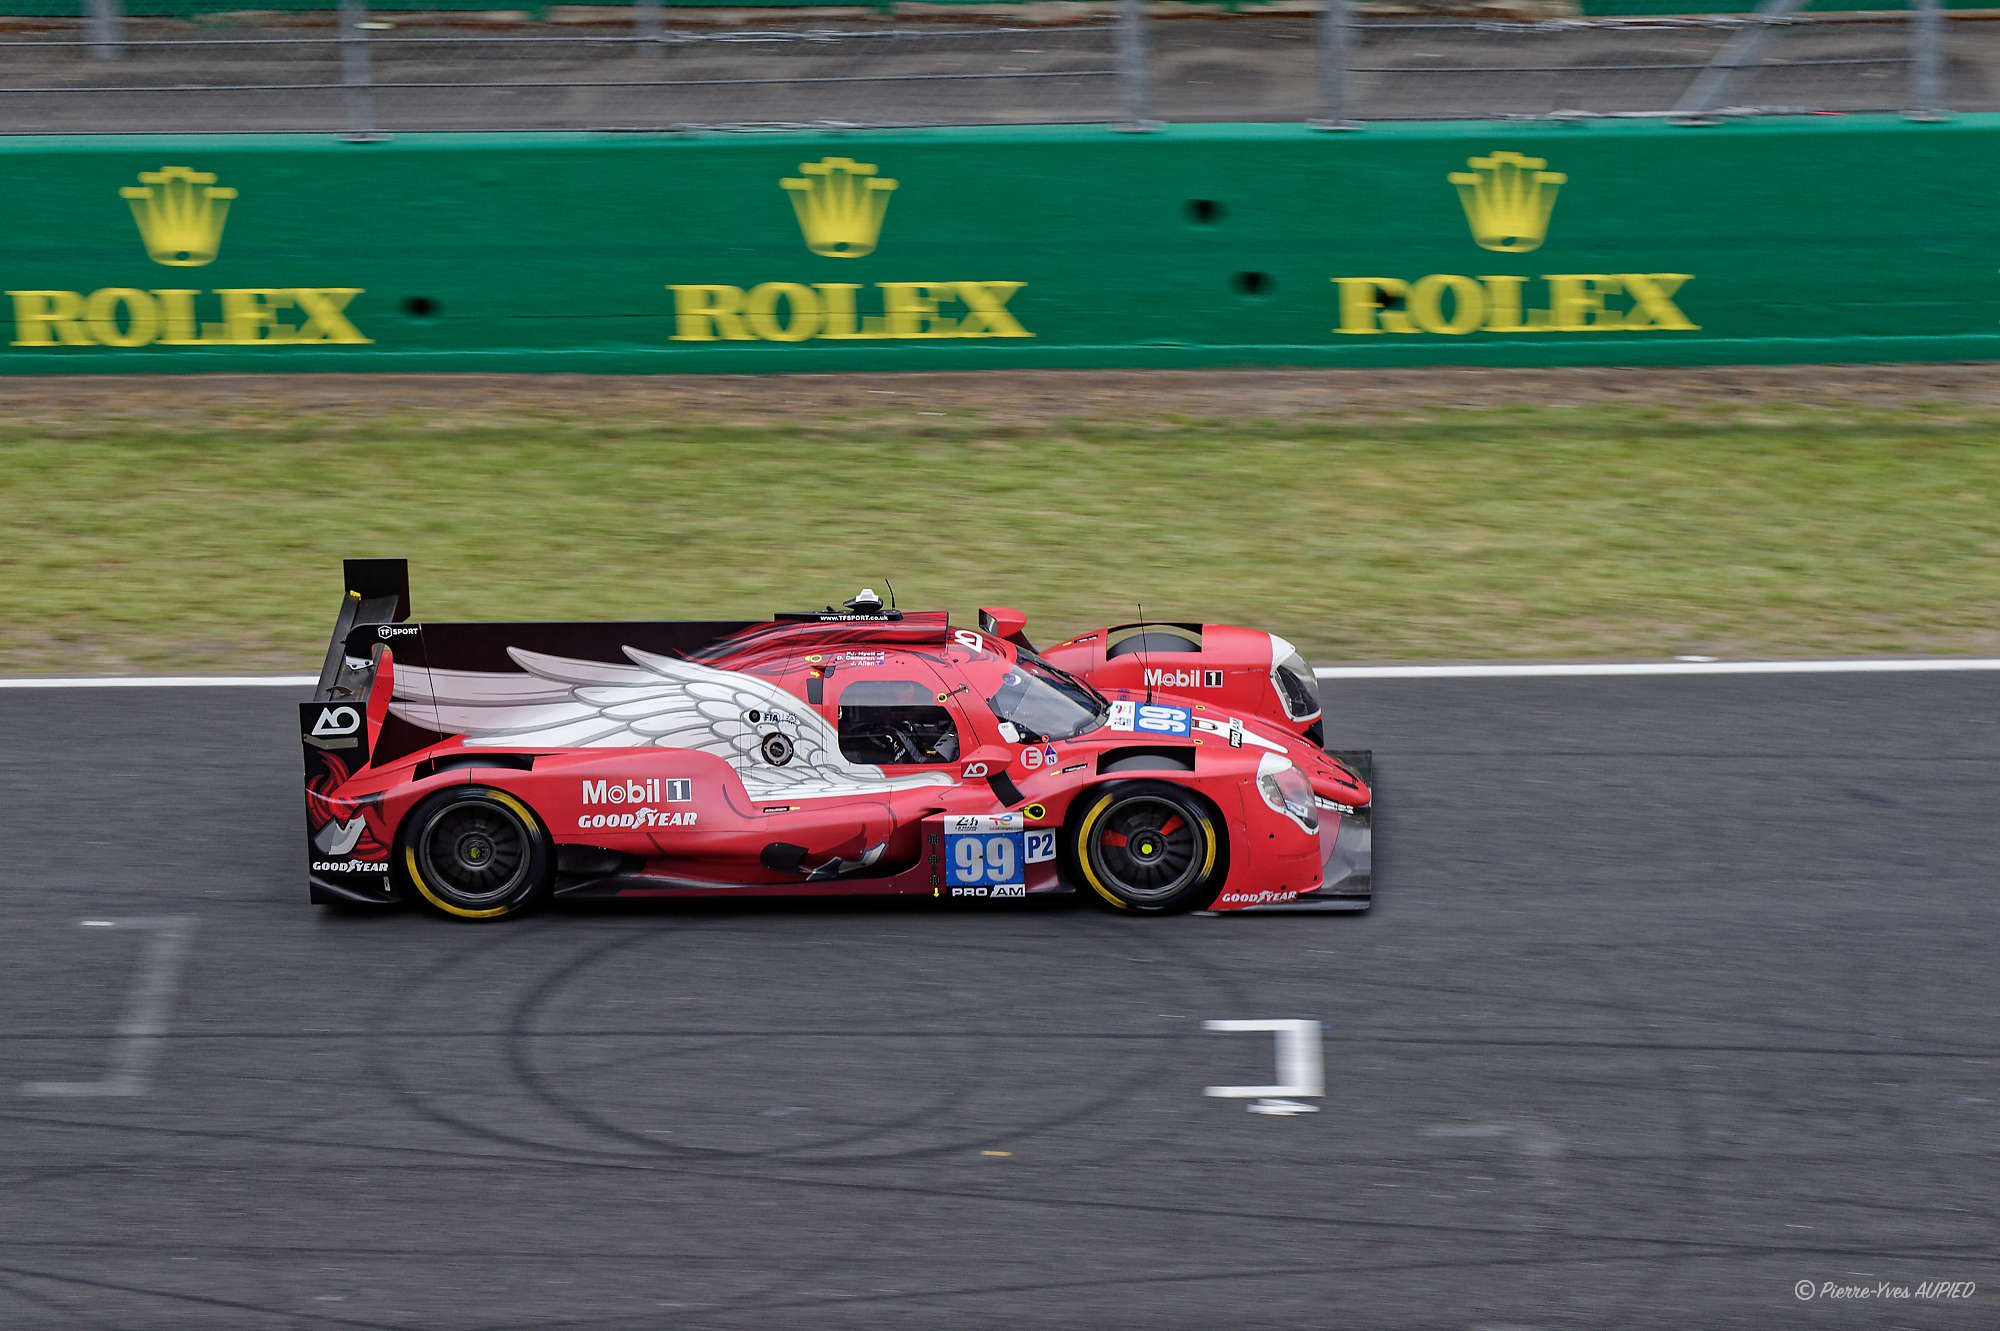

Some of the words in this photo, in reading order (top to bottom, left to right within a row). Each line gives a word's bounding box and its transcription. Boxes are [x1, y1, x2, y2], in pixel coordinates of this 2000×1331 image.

[4, 287, 375, 347] ROLEX
[665, 281, 1037, 342] ROLEX
[1330, 273, 1702, 335] ROLEX
[392, 627, 418, 635] SPORT
[1144, 668, 1200, 687] Mobil
[1138, 705, 1187, 732] 99
[1025, 750, 1038, 766] E
[582, 778, 660, 804] Mobil
[578, 808, 697, 829] GOODYEAR
[1027, 833, 1054, 859] P2
[312, 860, 389, 872] GOODYEAR
[955, 837, 1015, 882] 99
[1221, 889, 1298, 903] GOODYEAR
